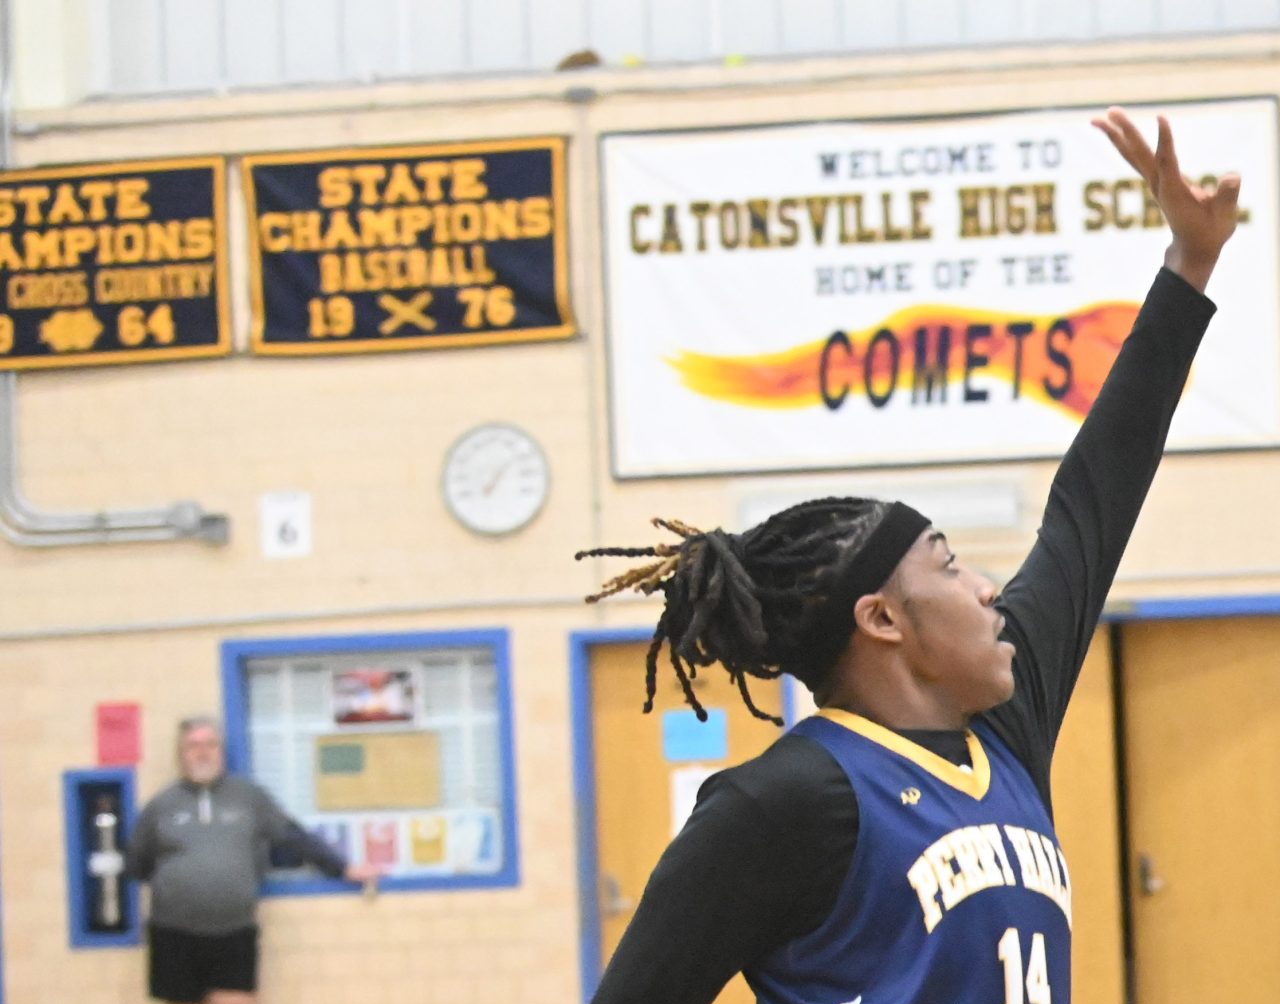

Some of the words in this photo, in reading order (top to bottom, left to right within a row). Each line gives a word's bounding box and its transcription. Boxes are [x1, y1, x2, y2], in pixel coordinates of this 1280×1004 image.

[318, 157, 489, 209] STATE
[817, 142, 994, 181] WELCOME
[1016, 139, 1062, 169] TO
[259, 195, 553, 253] CHAMPIONS
[629, 189, 933, 254] CATONSVILLE
[957, 181, 1057, 239] HIGH
[318, 244, 497, 294] BASEBALL
[815, 262, 914, 295] HOME
[935, 258, 979, 290] OF
[1000, 253, 1073, 286] THE
[117, 303, 176, 347] 64
[307, 294, 356, 338] 19
[456, 284, 516, 329] 76
[818, 317, 1076, 411] COMETS
[277, 518, 299, 547] 6
[906, 823, 1017, 935] PERRY
